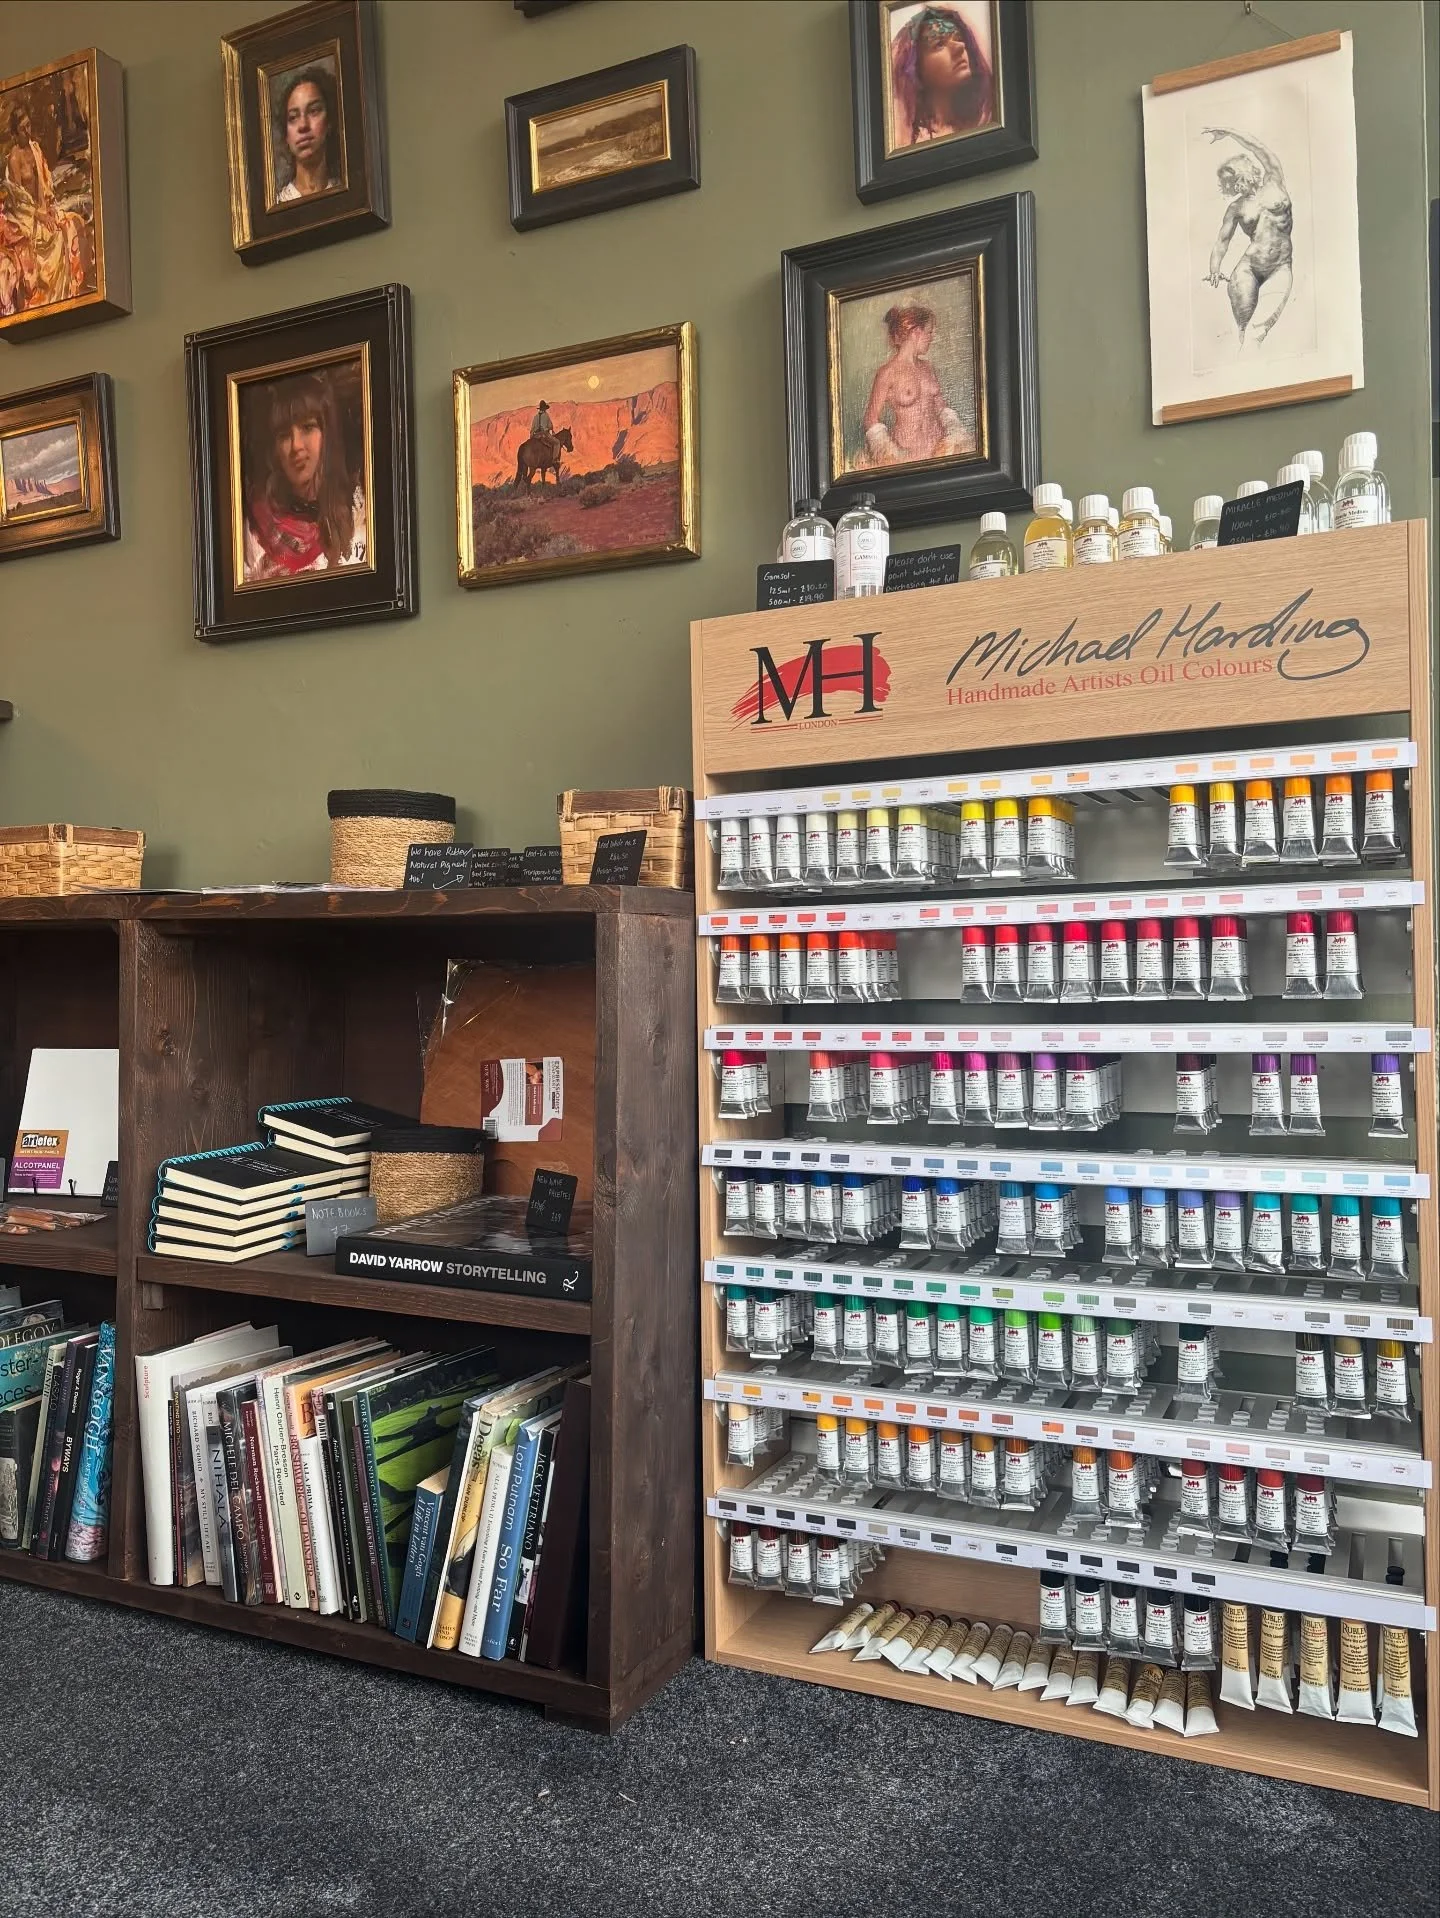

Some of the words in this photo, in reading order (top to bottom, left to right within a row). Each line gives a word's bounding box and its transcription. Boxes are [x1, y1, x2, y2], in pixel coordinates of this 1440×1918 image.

[1225, 501, 1261, 515] MIRACLE
[887, 569, 908, 582] paint
[913, 563, 946, 576] without
[888, 556, 914, 568] Please
[940, 552, 955, 561] use
[769, 586, 791, 595] 125ml
[886, 581, 926, 593] purchasing
[768, 598, 791, 606] 500ml
[946, 608, 1163, 686] Michael
[1156, 588, 1371, 681] Harding
[749, 632, 883, 724] MH
[947, 677, 1056, 706] Handmade
[1063, 671, 1132, 694] Artists
[1140, 663, 1175, 685] Oil
[1183, 656, 1273, 681] Colours
[798, 719, 839, 731] LONDON
[410, 846, 422, 856] We
[424, 847, 442, 856] have
[410, 860, 437, 869] Natural
[22, 1134, 59, 1148] artefex
[349, 1252, 387, 1267] DAVID
[389, 1256, 443, 1274] YARROW
[446, 1262, 547, 1285] STORYTELLING
[75, 1368, 83, 1385] Roger
[95, 1348, 113, 1387] VAN
[71, 1391, 79, 1414] Deakins
[86, 1389, 105, 1453] GOGH
[191, 1410, 200, 1443] RICHARD
[62, 1436, 73, 1473] BYWAYS
[223, 1421, 237, 1468] MICHELE
[276, 1412, 289, 1478] Cartier-Bresson
[360, 1399, 371, 1450] YORKSHIRE
[366, 1454, 379, 1513] LANDSCAPES
[471, 1420, 493, 1469] Degas
[515, 1444, 527, 1472] Lori
[195, 1445, 203, 1472] SCHMID
[249, 1436, 257, 1466] Norman
[253, 1467, 262, 1501] Rockwell
[290, 1434, 304, 1500] BRUSHWORK
[535, 1452, 547, 1480] JACK
[200, 1488, 206, 1500] MY
[229, 1471, 239, 1490] DEL
[276, 1468, 285, 1506] Revisited
[77, 1463, 92, 1526] RETROSPECTIVE
[305, 1485, 313, 1510] PRIMA
[419, 1496, 426, 1505] A
[490, 1491, 498, 1513] PRIMA
[505, 1474, 523, 1531] Putnam
[232, 1495, 245, 1540] CAMPO
[300, 1511, 308, 1527] OIL
[414, 1504, 425, 1522] Life
[423, 1502, 435, 1536] Vincent
[461, 1496, 470, 1522] DUNLOP
[524, 1484, 542, 1550] VETTRIANO
[364, 1517, 372, 1541] HUMAN
[368, 1542, 376, 1565] FIGURE
[413, 1523, 420, 1533] in
[484, 1519, 494, 1546] Everything
[302, 1530, 313, 1577] PAINTER
[409, 1534, 419, 1563] Letters
[420, 1536, 428, 1551] van
[498, 1544, 513, 1570] So
[416, 1553, 427, 1577] Gogh
[491, 1575, 508, 1613] Far
